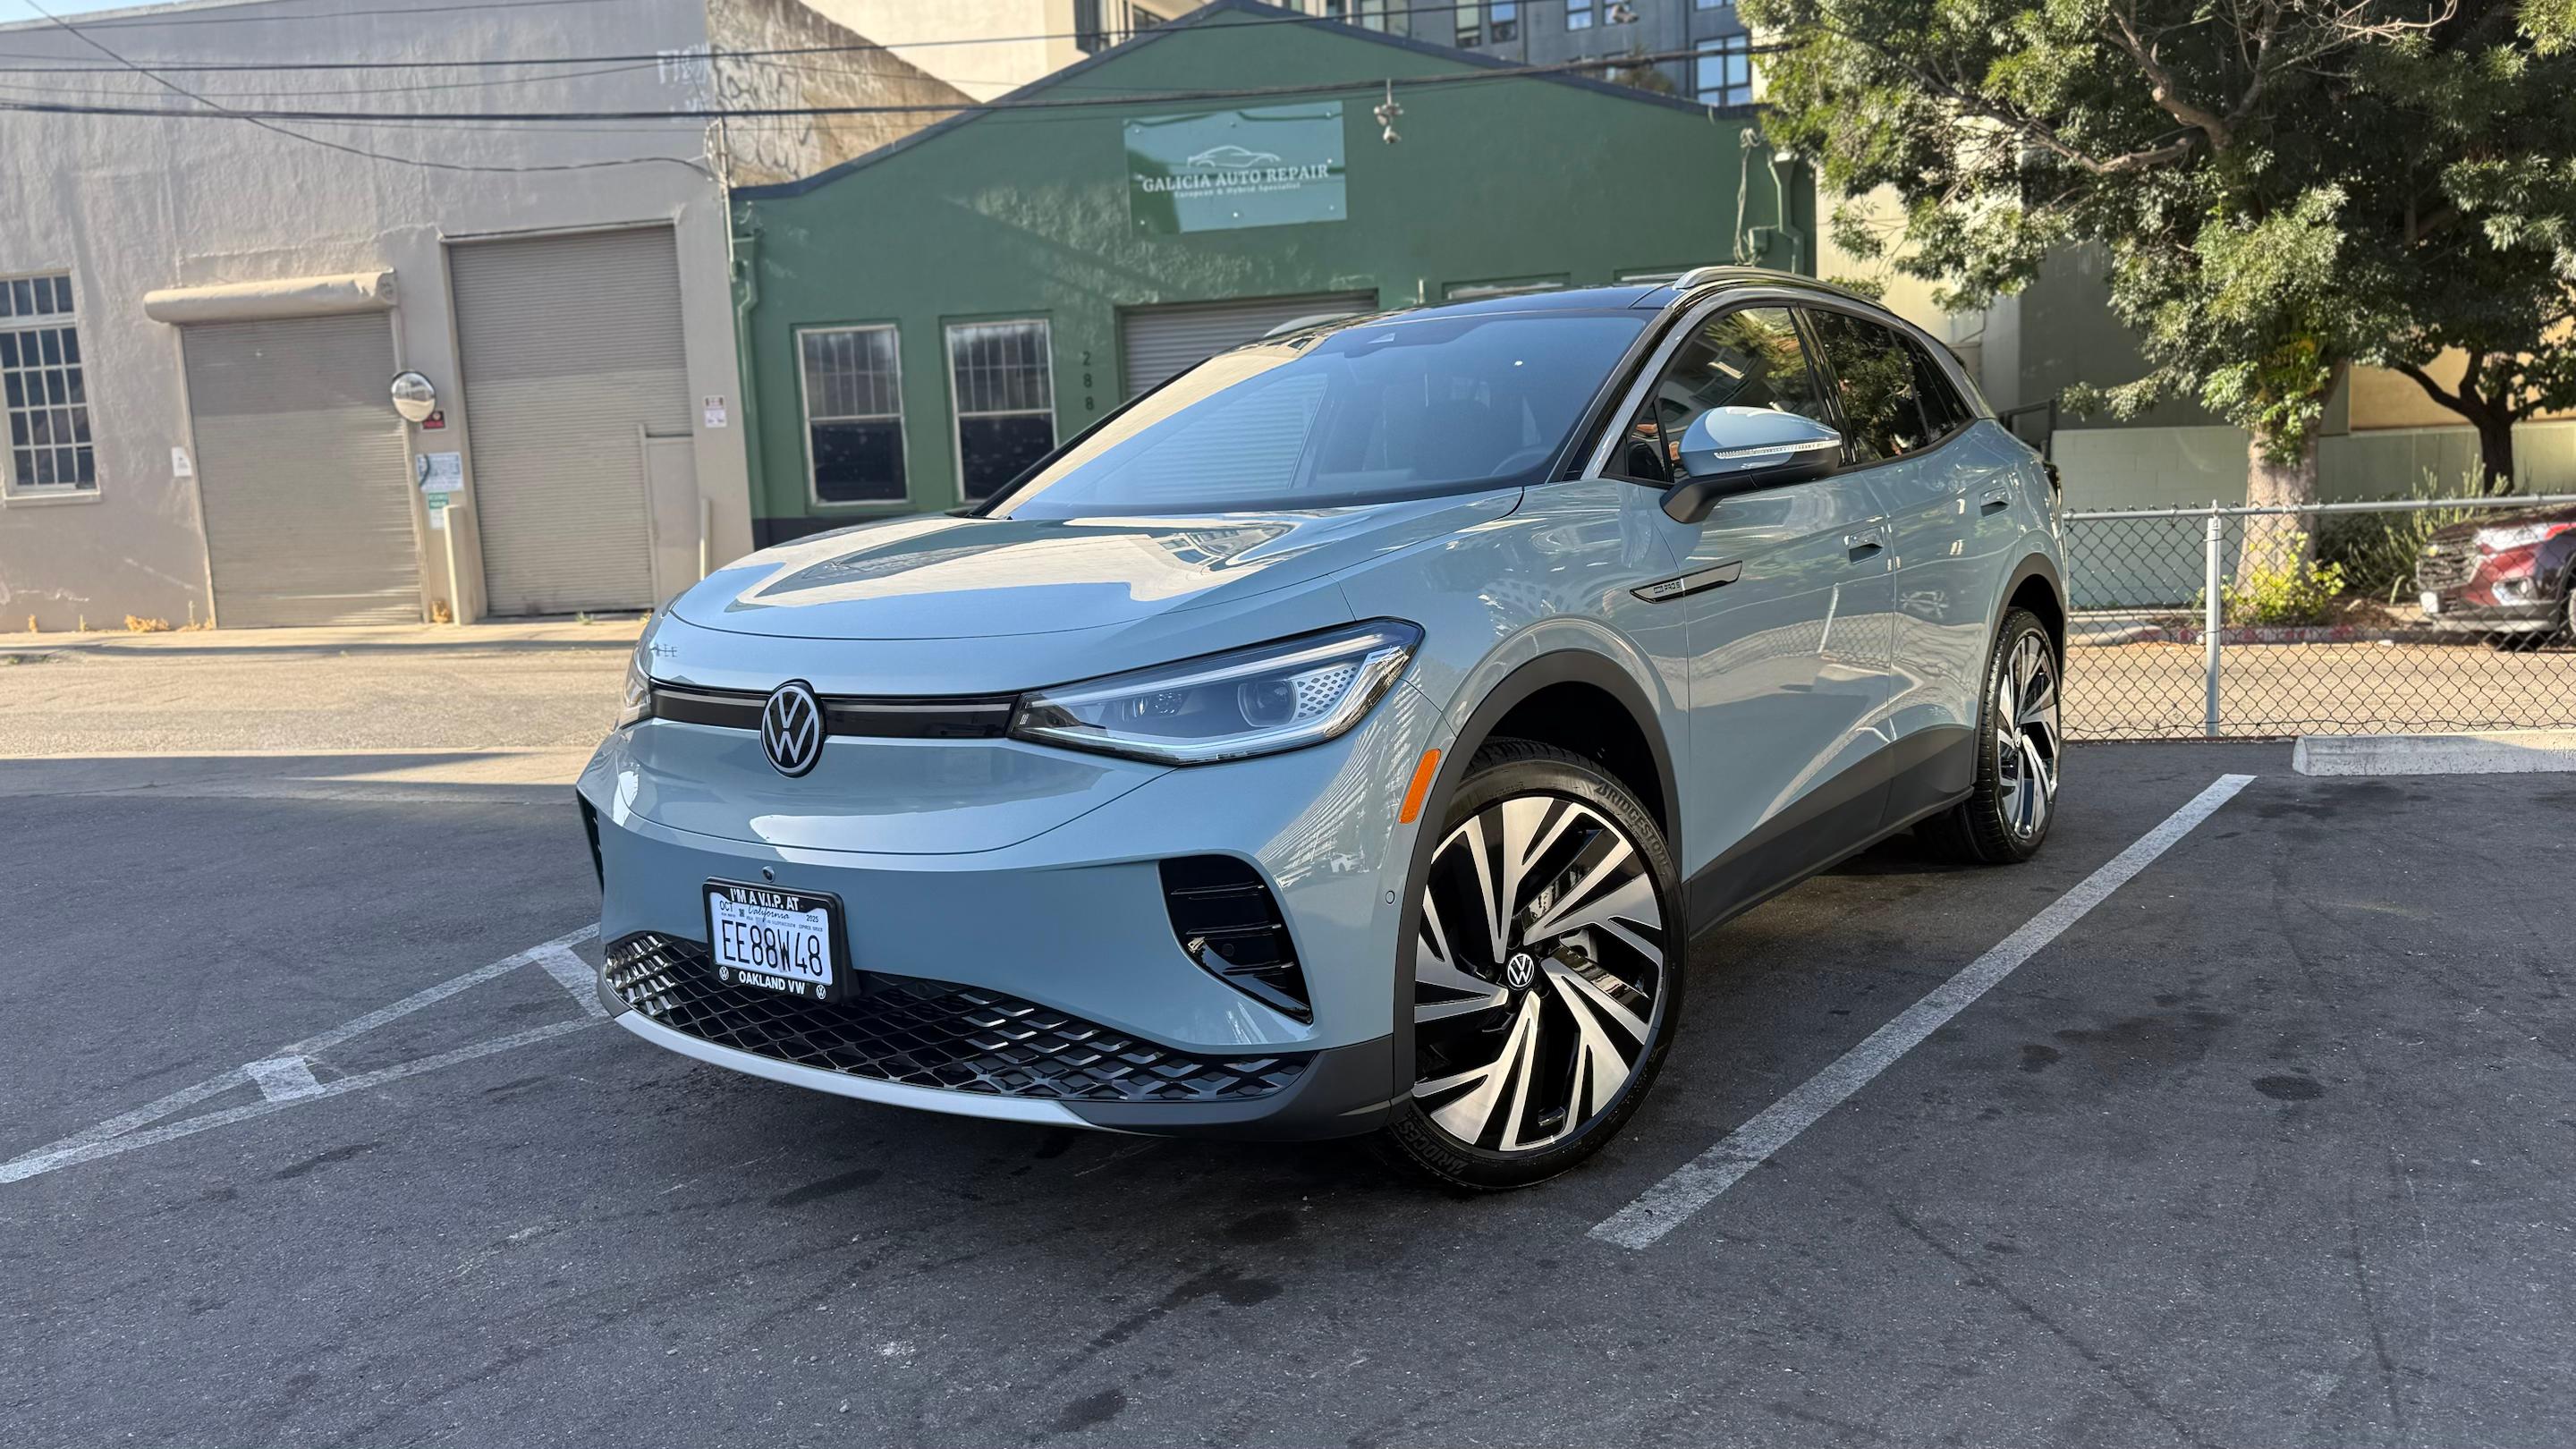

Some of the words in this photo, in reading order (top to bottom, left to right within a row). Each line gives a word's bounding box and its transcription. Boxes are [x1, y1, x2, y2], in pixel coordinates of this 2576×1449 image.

[1143, 174, 1211, 192] GALICIA
[1216, 170, 1261, 187] AUTO
[1267, 165, 1329, 182] REPAIR
[1174, 189, 1214, 199] European
[1226, 185, 1256, 195] Hybrid
[1082, 350, 1094, 411] 288
[763, 687, 818, 772] VW
[719, 900, 733, 912] OCT
[730, 887, 747, 904] I'M
[750, 891, 758, 905] A
[758, 892, 784, 910] V.I.P.
[786, 896, 800, 911] AT
[806, 914, 819, 923] 2025
[722, 919, 823, 977] EE88W48
[738, 970, 785, 991] OAKLAND
[785, 979, 805, 995] VW
[1508, 953, 1534, 987] VW
